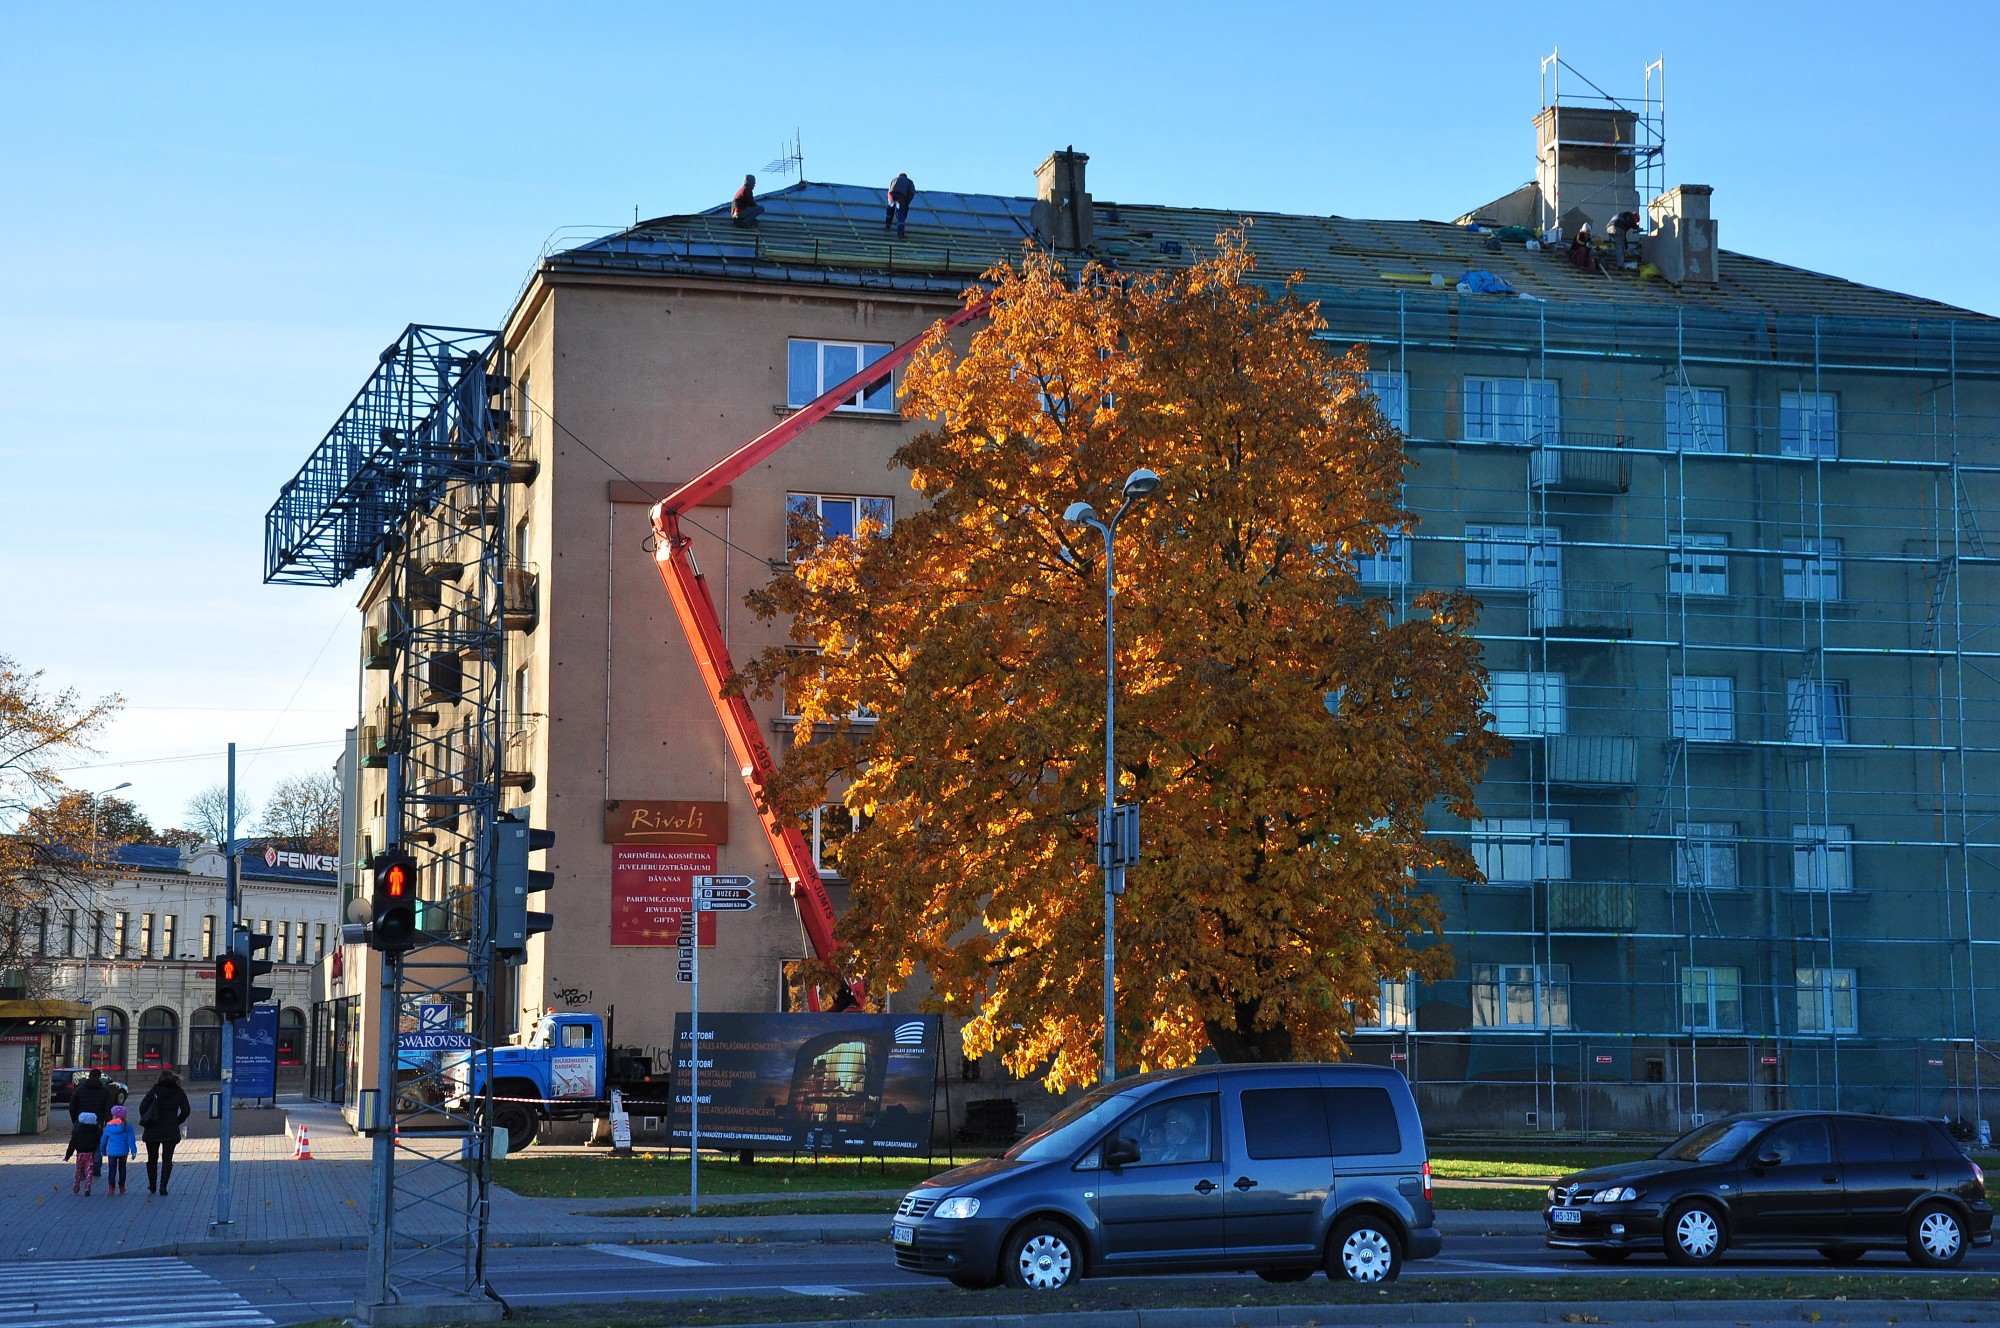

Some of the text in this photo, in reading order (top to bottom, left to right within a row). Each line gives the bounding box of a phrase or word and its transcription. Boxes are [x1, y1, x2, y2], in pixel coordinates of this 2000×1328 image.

[631, 806, 703, 829] Rivoli
[618, 851, 711, 860] PARFIMĒRIJA, KOSMĒTIKA
[276, 850, 339, 872] FENIKSS
[618, 863, 711, 871] JUVELIERU IZSTRĀDĀJUMI
[648, 874, 681, 882] DĀVANAS
[814, 884, 834, 920] JUMTS
[688, 1030, 714, 1040] OTOBRĪ
[687, 1058, 713, 1068] OTOBRĪ
